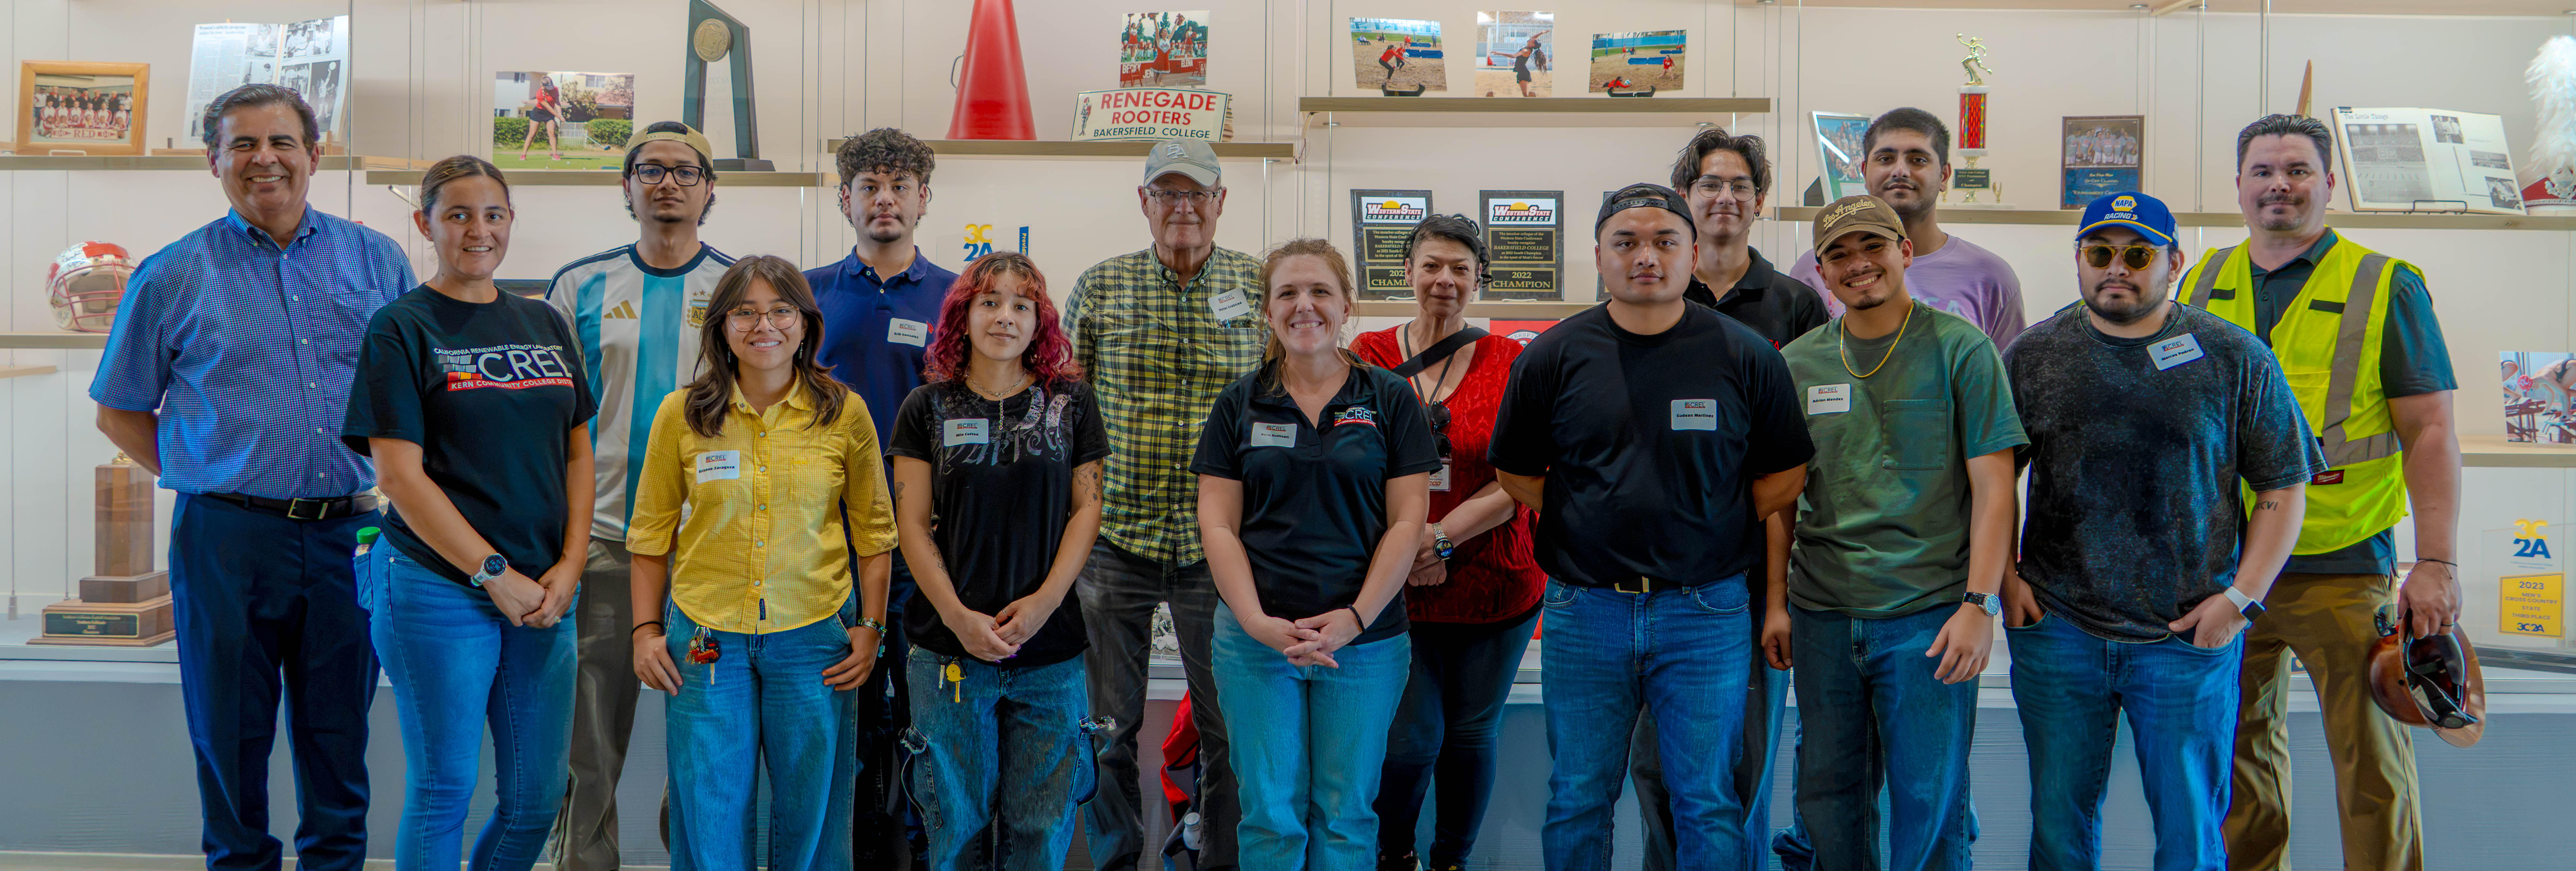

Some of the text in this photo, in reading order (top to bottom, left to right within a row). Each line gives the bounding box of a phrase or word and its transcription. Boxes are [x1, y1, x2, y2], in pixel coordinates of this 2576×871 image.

[1181, 59, 1193, 67] ELENA
[1101, 92, 1217, 111] RENEGADE
[1111, 110, 1191, 125] ROOTERS
[74, 130, 95, 138] RED
[1094, 127, 1210, 138] BAKERSFIELD COLLEGE
[1401, 204, 1421, 215] STATE
[1529, 206, 1551, 216] STATE
[1823, 199, 1874, 228] Los Angeles
[964, 224, 993, 244] 3C
[963, 242, 993, 262] 2A
[470, 345, 509, 354] RENEWABLE
[477, 350, 573, 382] CREL
[1345, 410, 1376, 424] CREL
[2513, 518, 2548, 541] 3C
[2512, 538, 2552, 559] 2A
[2519, 581, 2544, 590] 2023
